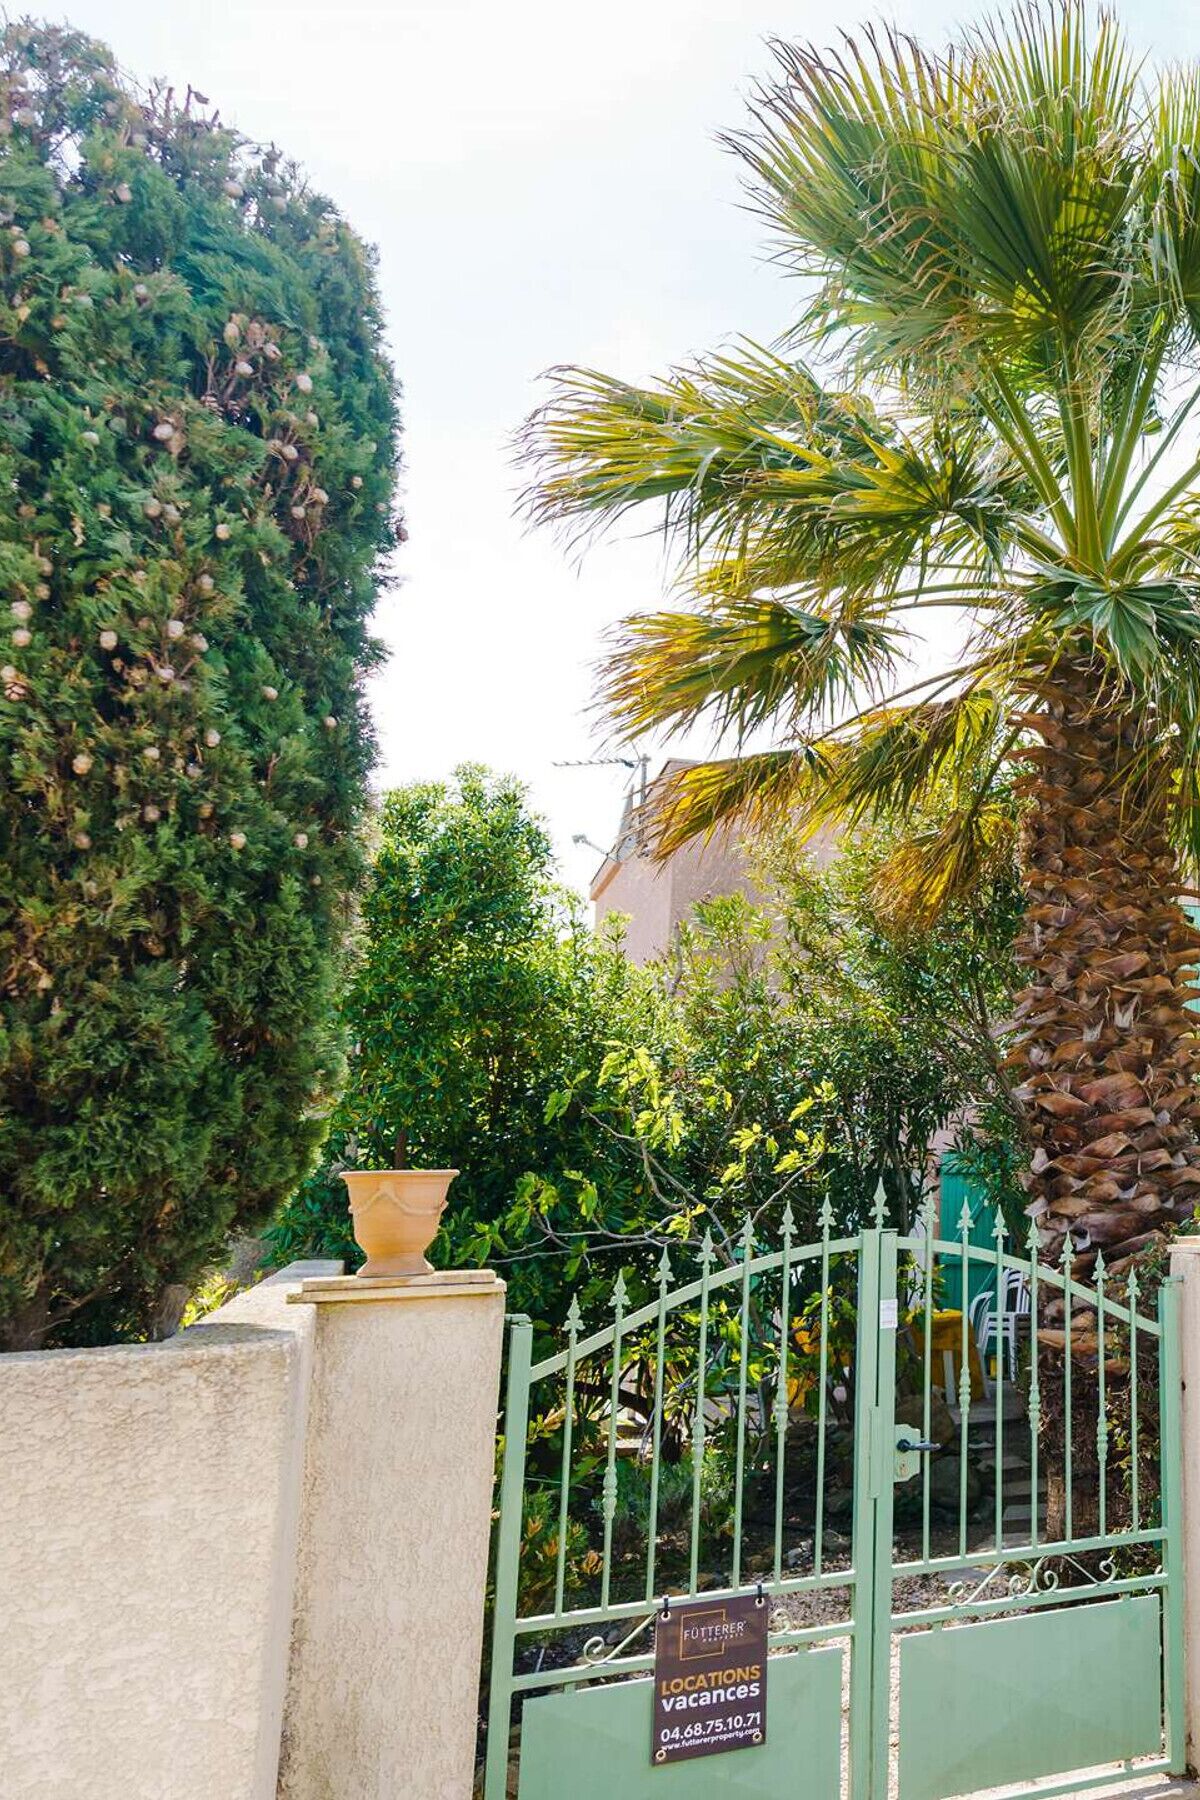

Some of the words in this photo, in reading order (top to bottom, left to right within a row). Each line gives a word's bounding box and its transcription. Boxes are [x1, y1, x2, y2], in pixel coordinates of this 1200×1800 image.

[661, 1665, 761, 1696] LOCATIONS
[661, 1683, 760, 1712] vacances
[661, 1712, 761, 1742] 04.68.75.10.71
